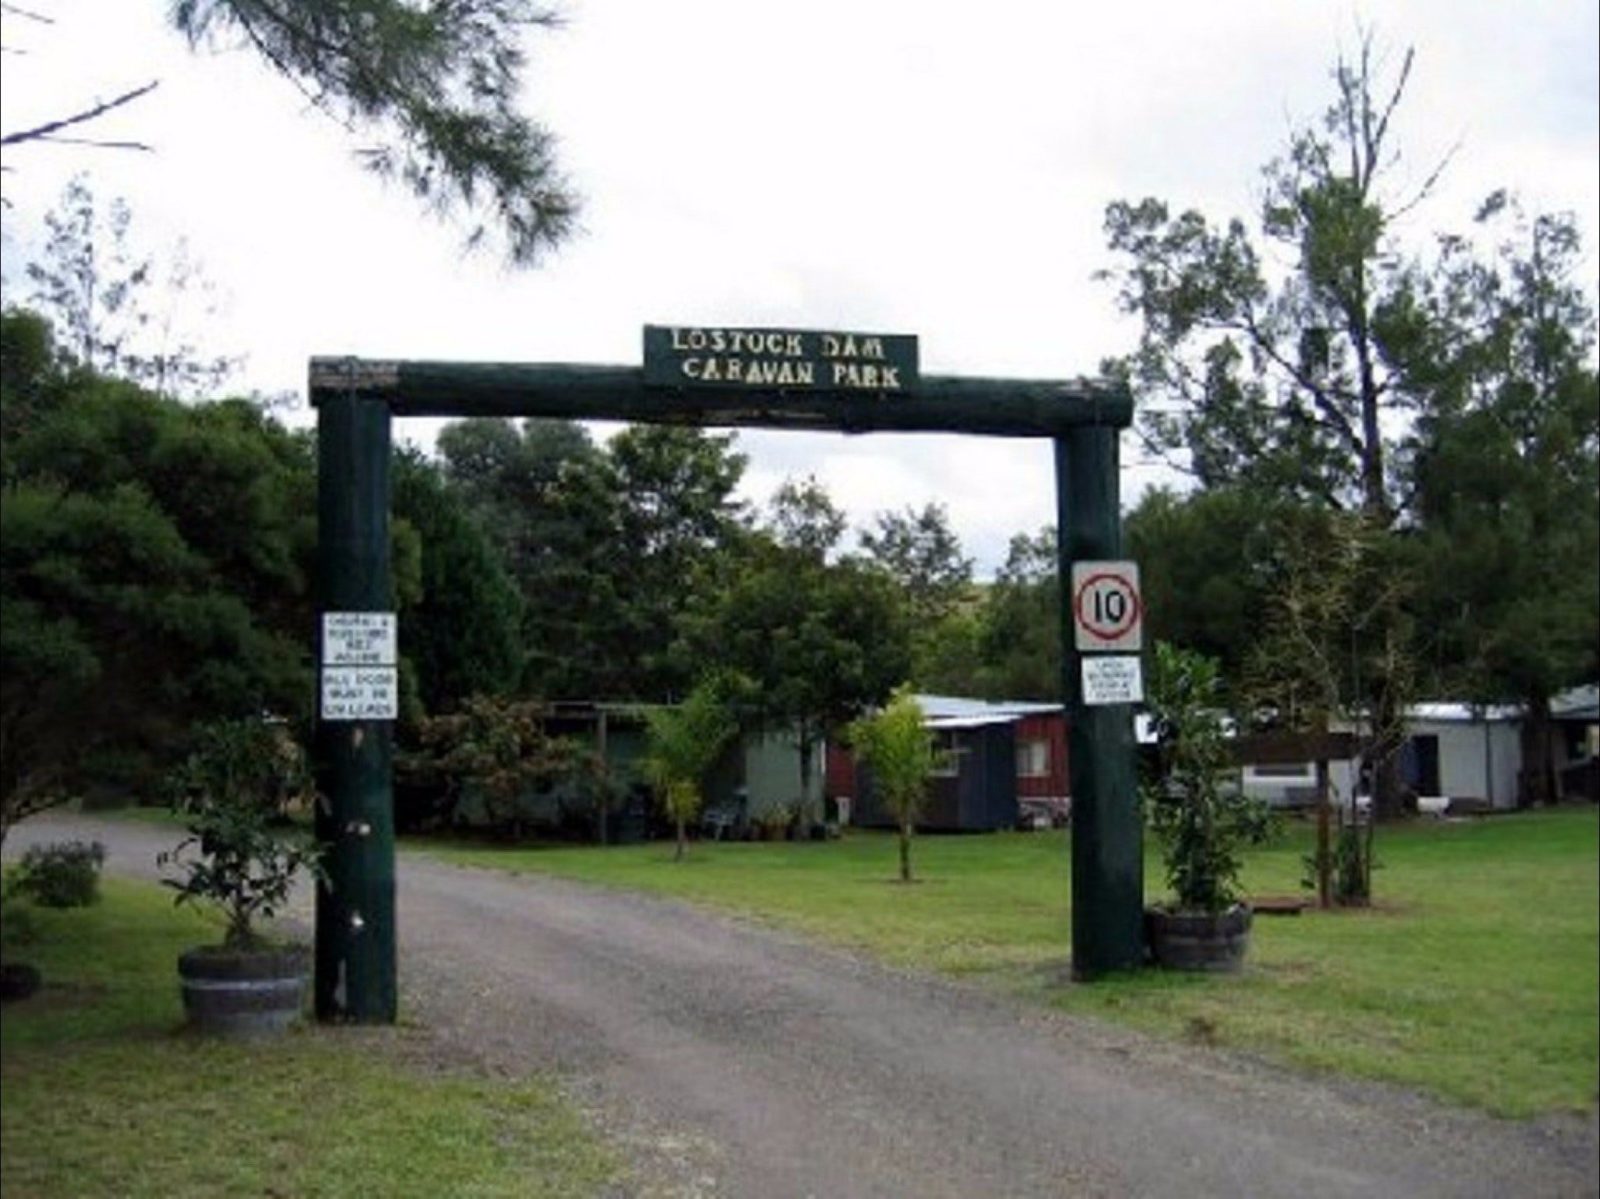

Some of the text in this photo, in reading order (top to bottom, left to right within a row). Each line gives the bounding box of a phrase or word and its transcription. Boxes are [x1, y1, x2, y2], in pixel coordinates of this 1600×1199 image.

[671, 328, 885, 358] LOSTOCK DAM
[682, 358, 901, 388] CARAVAN PARK
[1094, 590, 1127, 624] 10
